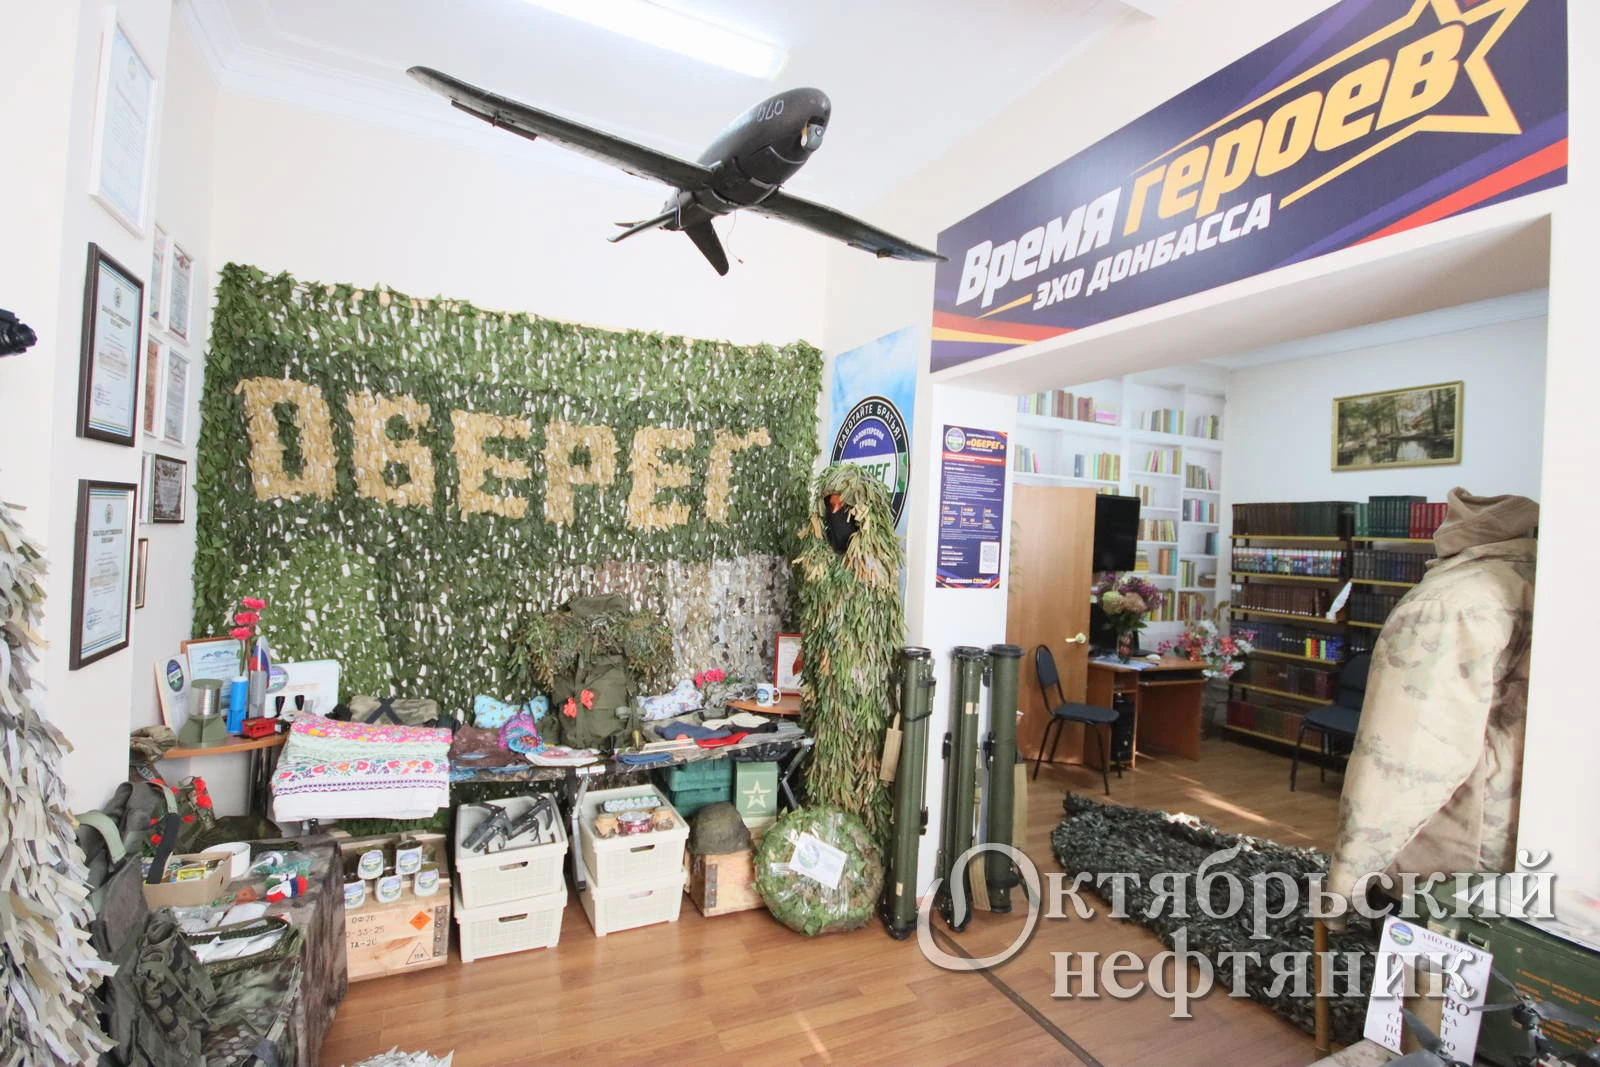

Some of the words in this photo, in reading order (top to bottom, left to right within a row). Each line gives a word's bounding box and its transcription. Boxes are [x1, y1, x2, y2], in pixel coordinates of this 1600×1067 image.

[956, 187, 1121, 309] Время
[1123, 24, 1465, 236] героев
[1086, 192, 1272, 296] ДОНБАССА
[233, 376, 771, 531] ОБЕРЕГ
[839, 404, 873, 449] РАБОТАЙТЕ
[876, 405, 902, 441] БРАТЬЯ!
